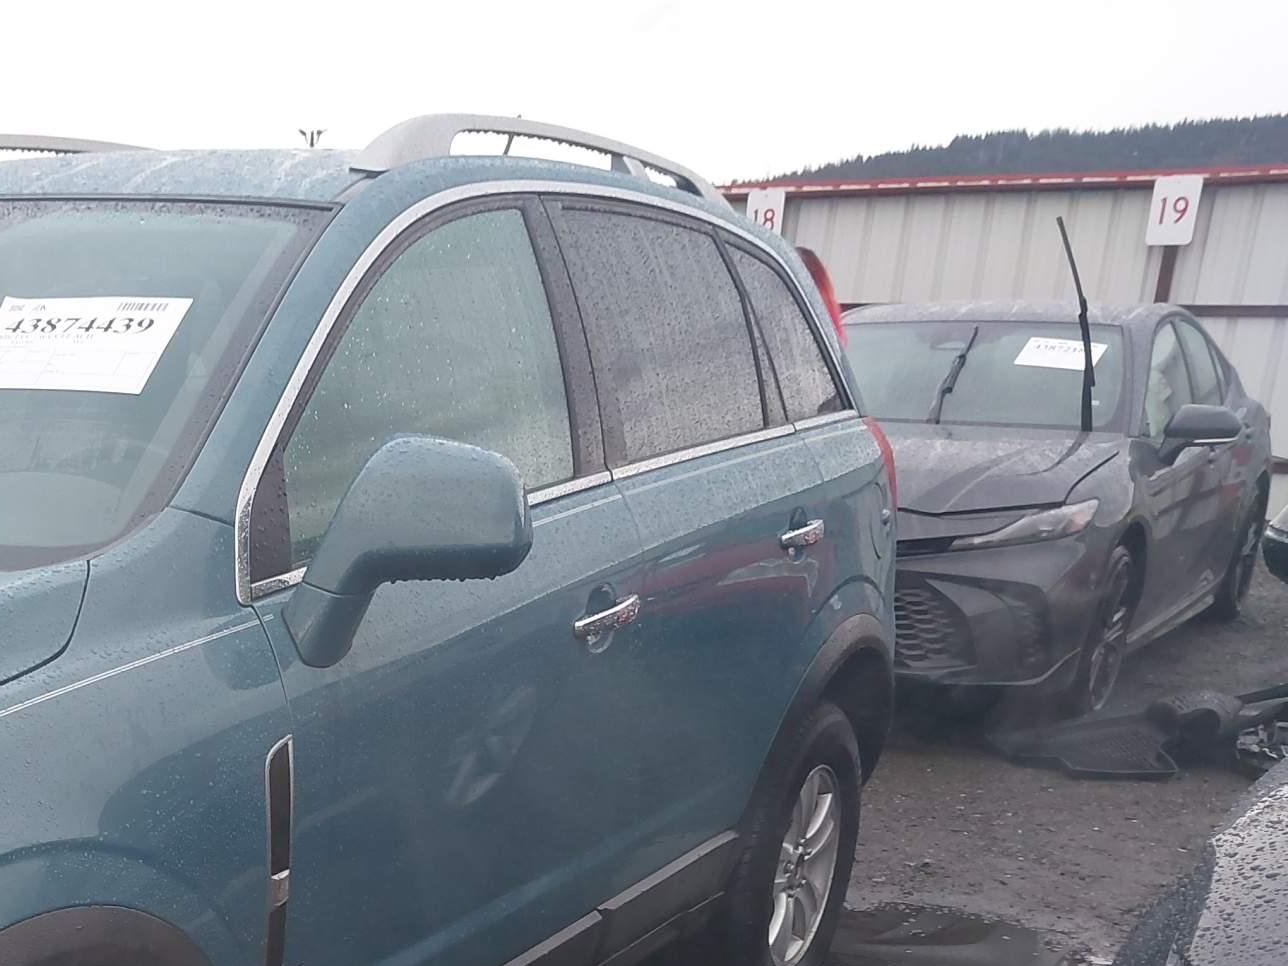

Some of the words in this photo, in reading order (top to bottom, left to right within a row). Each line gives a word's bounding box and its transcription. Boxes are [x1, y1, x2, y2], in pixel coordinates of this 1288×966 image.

[753, 208, 775, 231] 18
[1158, 196, 1189, 225] 19
[5, 317, 155, 334] 43874439
